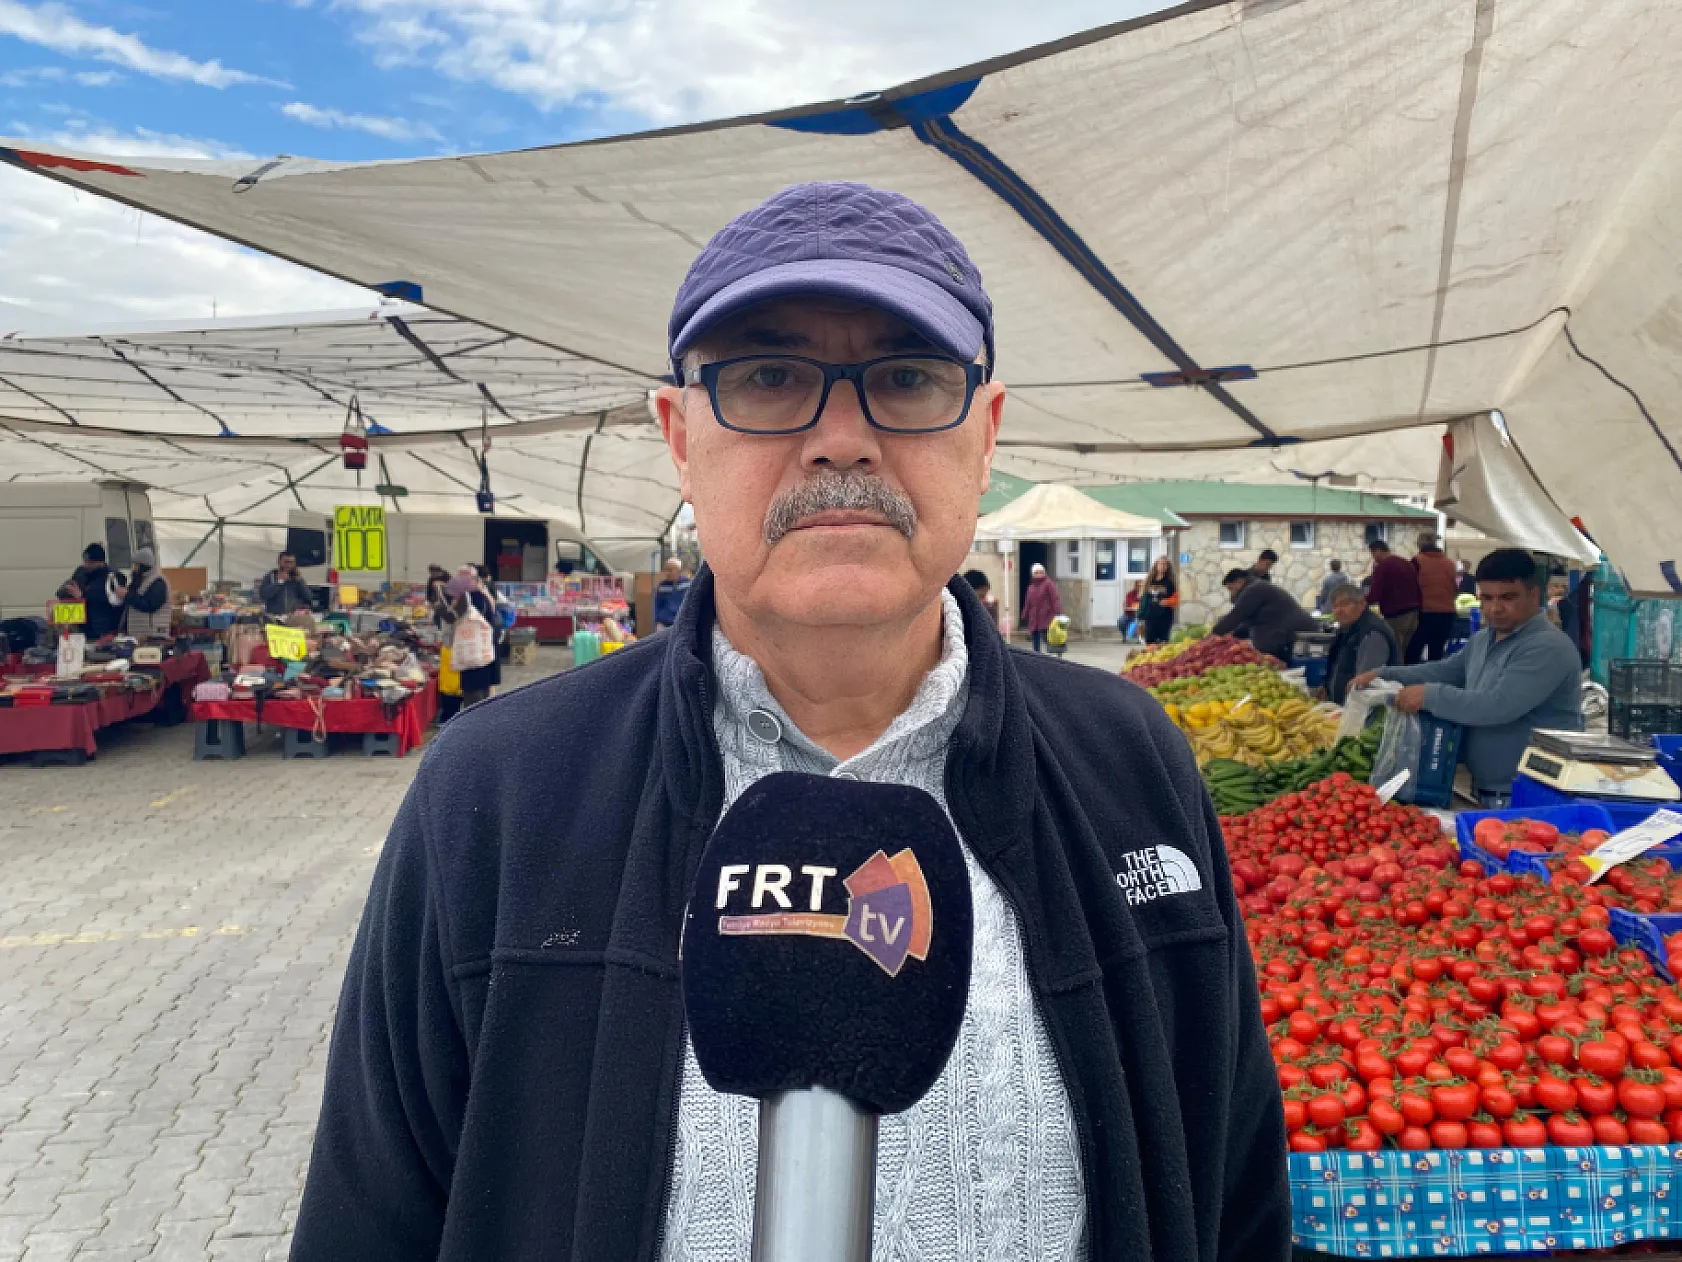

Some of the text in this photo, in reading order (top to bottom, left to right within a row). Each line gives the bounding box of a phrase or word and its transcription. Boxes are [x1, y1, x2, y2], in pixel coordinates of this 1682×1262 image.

[337, 528, 384, 570] 100
[1116, 859, 1164, 888] ORTH
[1121, 847, 1158, 872] THE
[715, 864, 838, 911] FRT
[1125, 881, 1172, 906] FACE
[859, 904, 905, 945] tv
